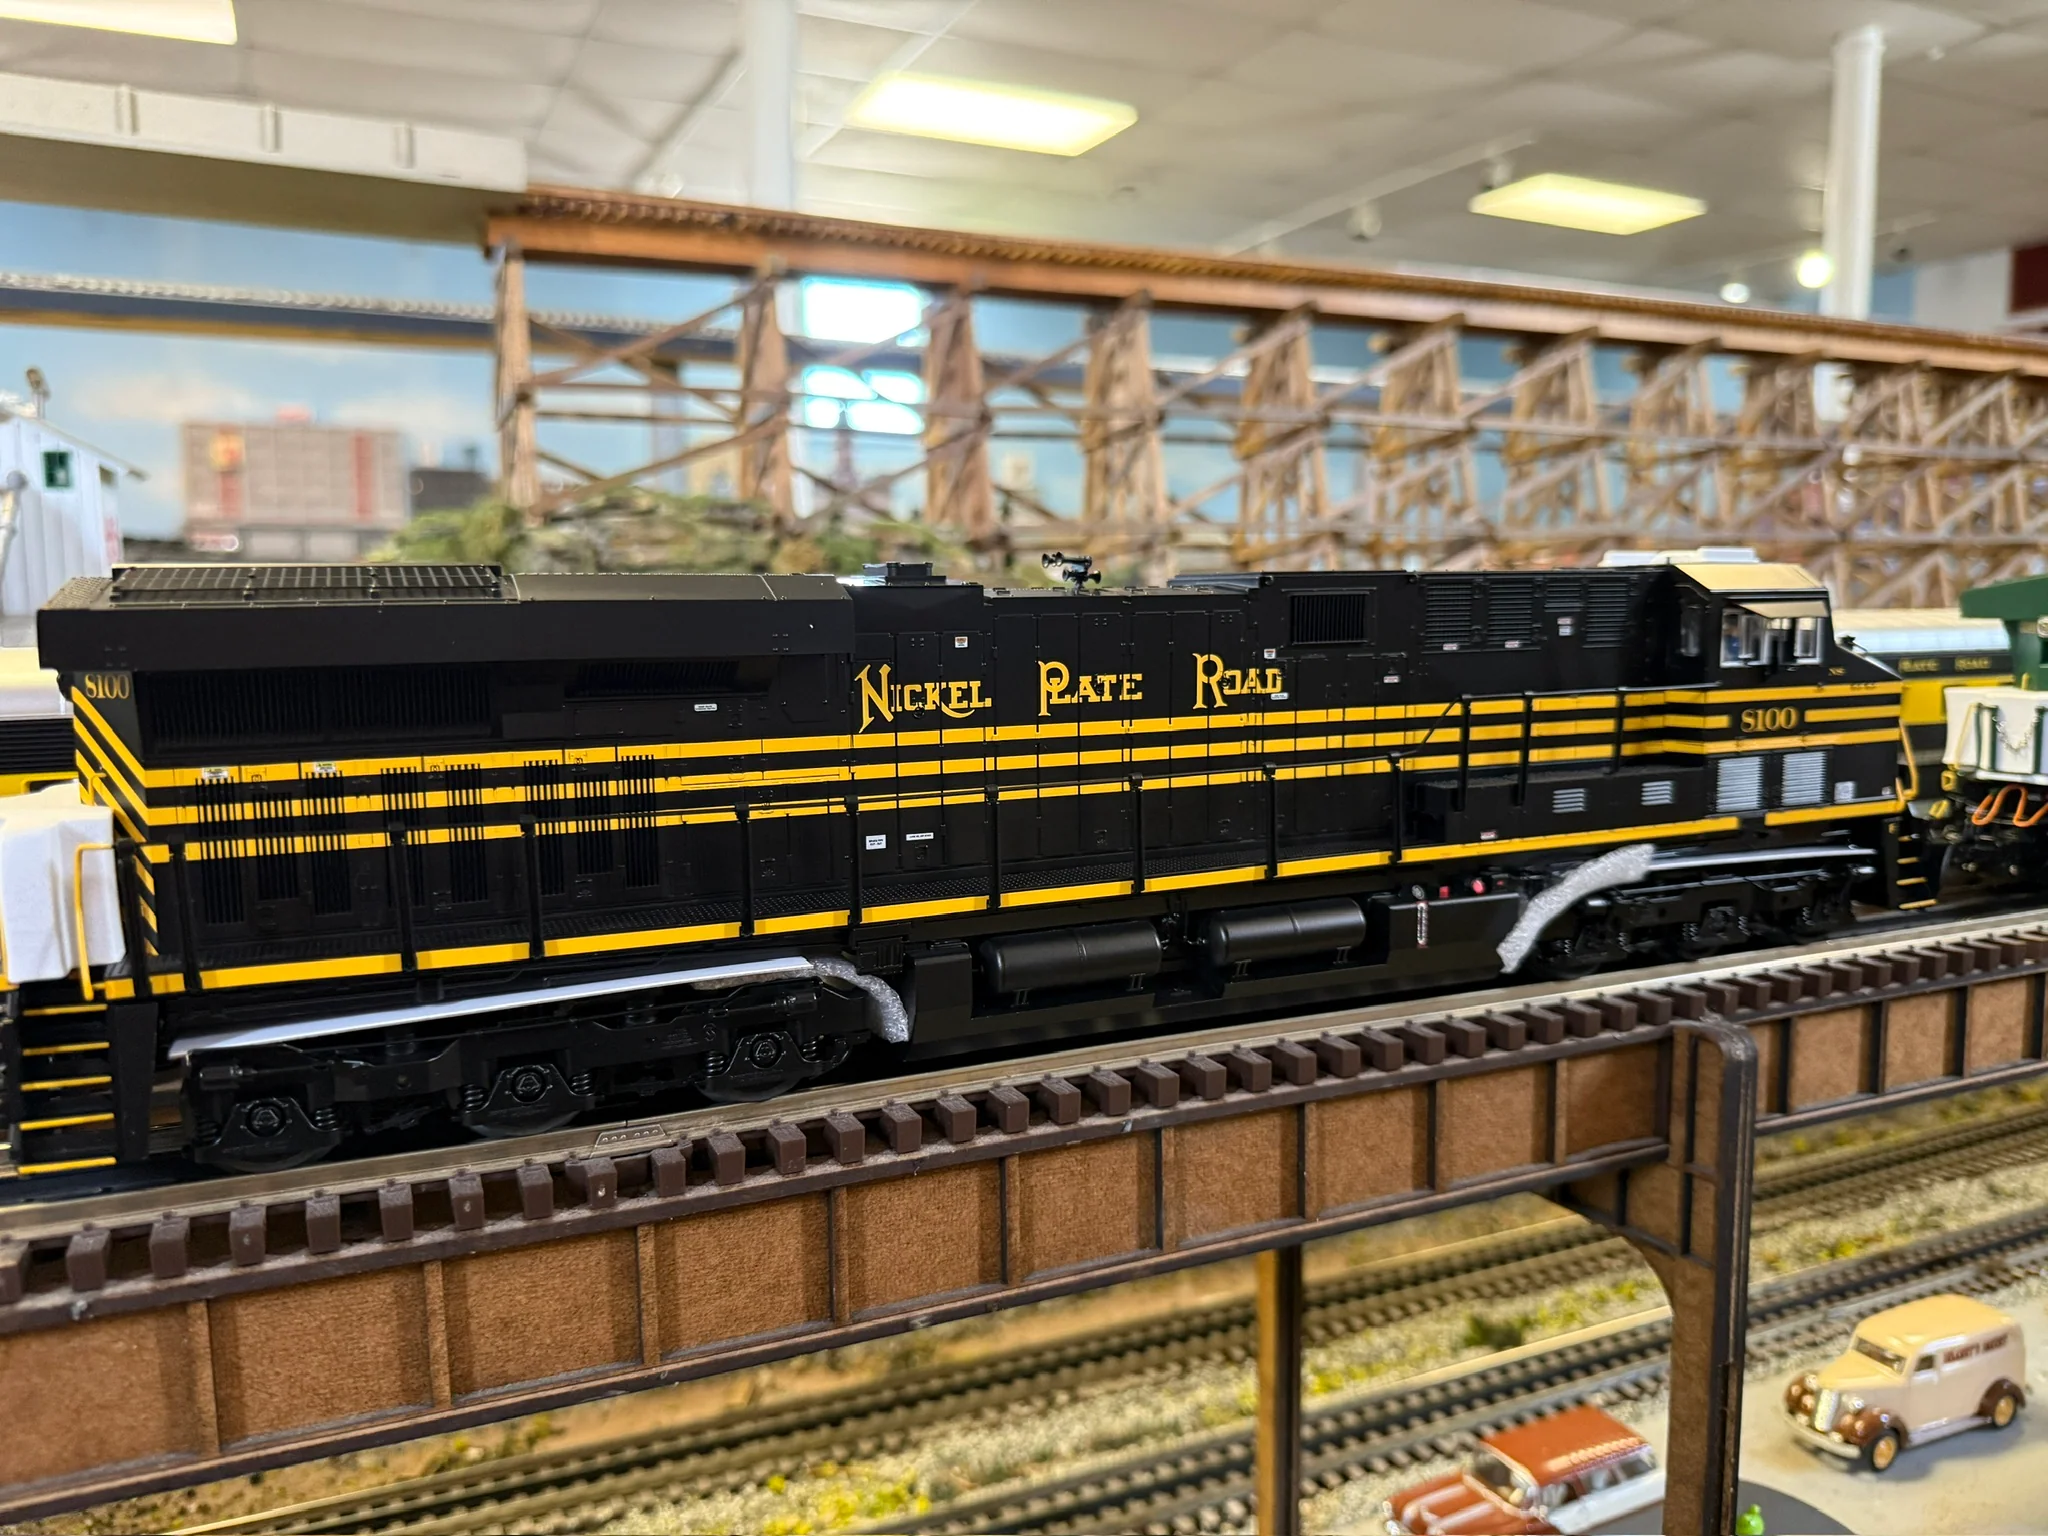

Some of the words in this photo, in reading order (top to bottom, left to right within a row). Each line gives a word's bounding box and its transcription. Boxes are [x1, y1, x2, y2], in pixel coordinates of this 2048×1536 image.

[85, 673, 130, 699] 8100
[854, 664, 992, 733] NICKEL
[1038, 660, 1143, 716] PLATE
[1192, 653, 1282, 709] ROAD
[1740, 706, 1799, 733] 8100
